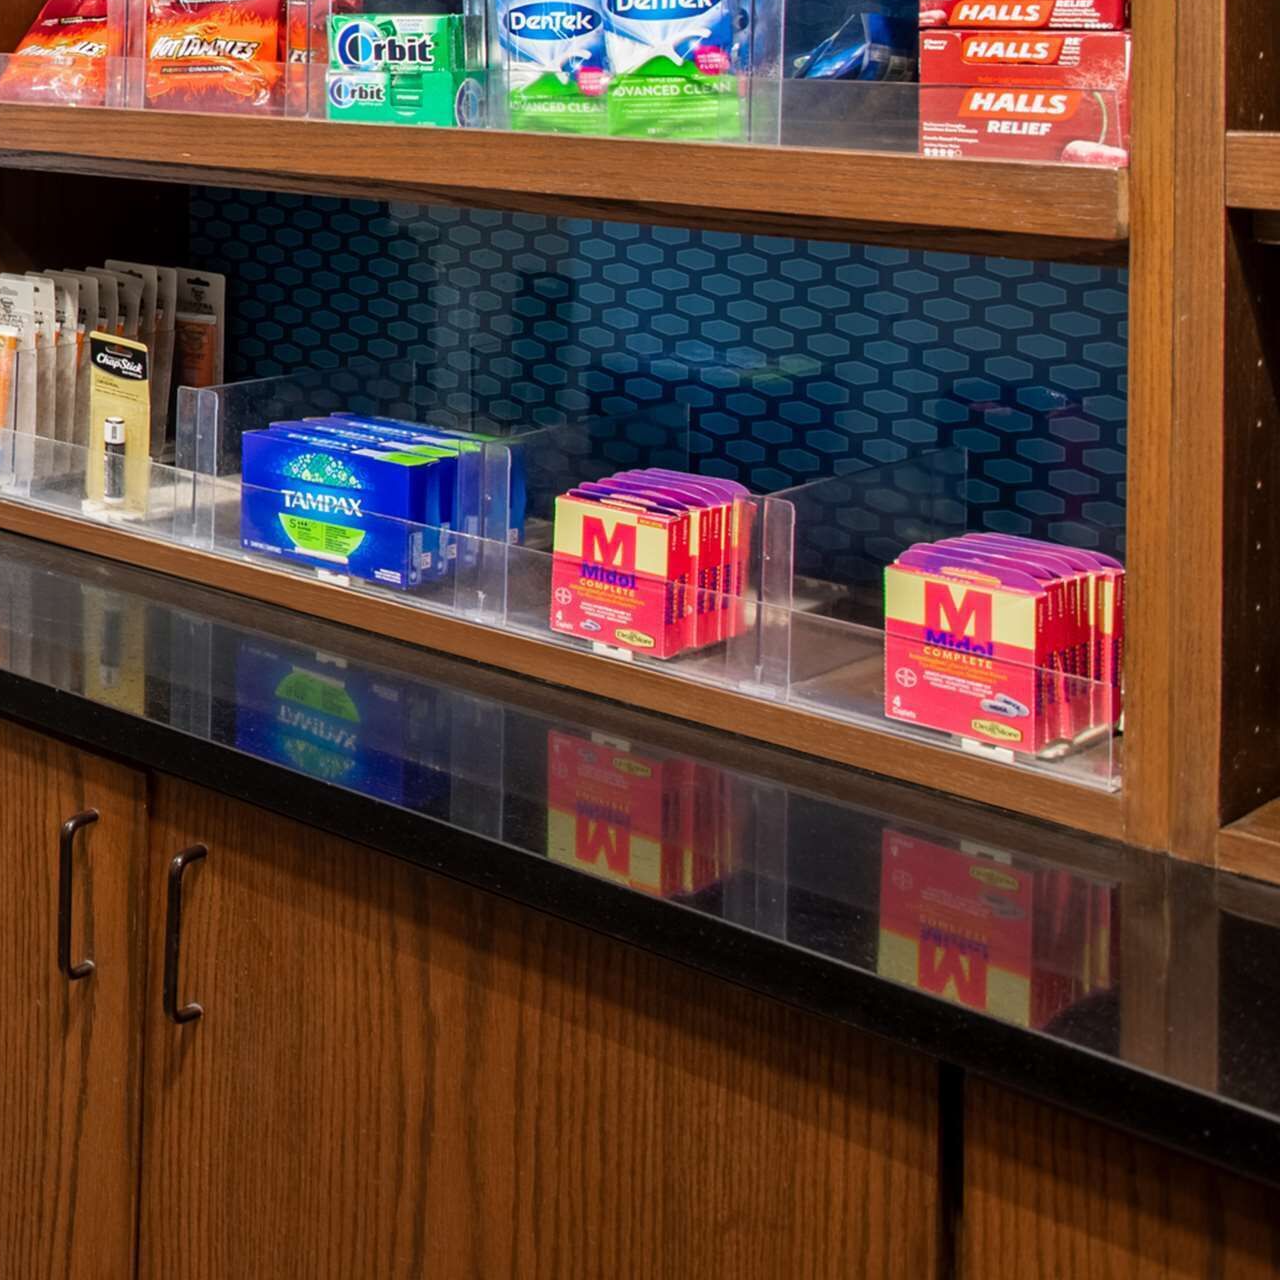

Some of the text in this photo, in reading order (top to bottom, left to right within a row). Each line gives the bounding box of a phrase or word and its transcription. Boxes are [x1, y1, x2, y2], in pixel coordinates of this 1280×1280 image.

[958, 4, 1041, 22] HALLS
[1055, 0, 1095, 8] RELIEF
[511, 11, 593, 31] DenTek
[151, 34, 260, 60] HOT TAMALES
[338, 21, 434, 72] Orbit
[966, 41, 1050, 59] HALLS
[329, 77, 385, 108] Orbit
[683, 81, 732, 94] CLEAN
[969, 92, 1068, 115] HALLS
[987, 120, 1052, 136] RELIEF
[96, 352, 143, 374] ChapStick
[281, 489, 363, 518] TAMPAX
[582, 514, 637, 568] M
[579, 578, 636, 597] COMPLETE
[580, 562, 636, 591] Midol
[555, 610, 562, 621] 4
[924, 581, 992, 637] M
[924, 628, 994, 658] Midol
[923, 646, 993, 670] COMPLETE
[892, 695, 901, 707] 4
